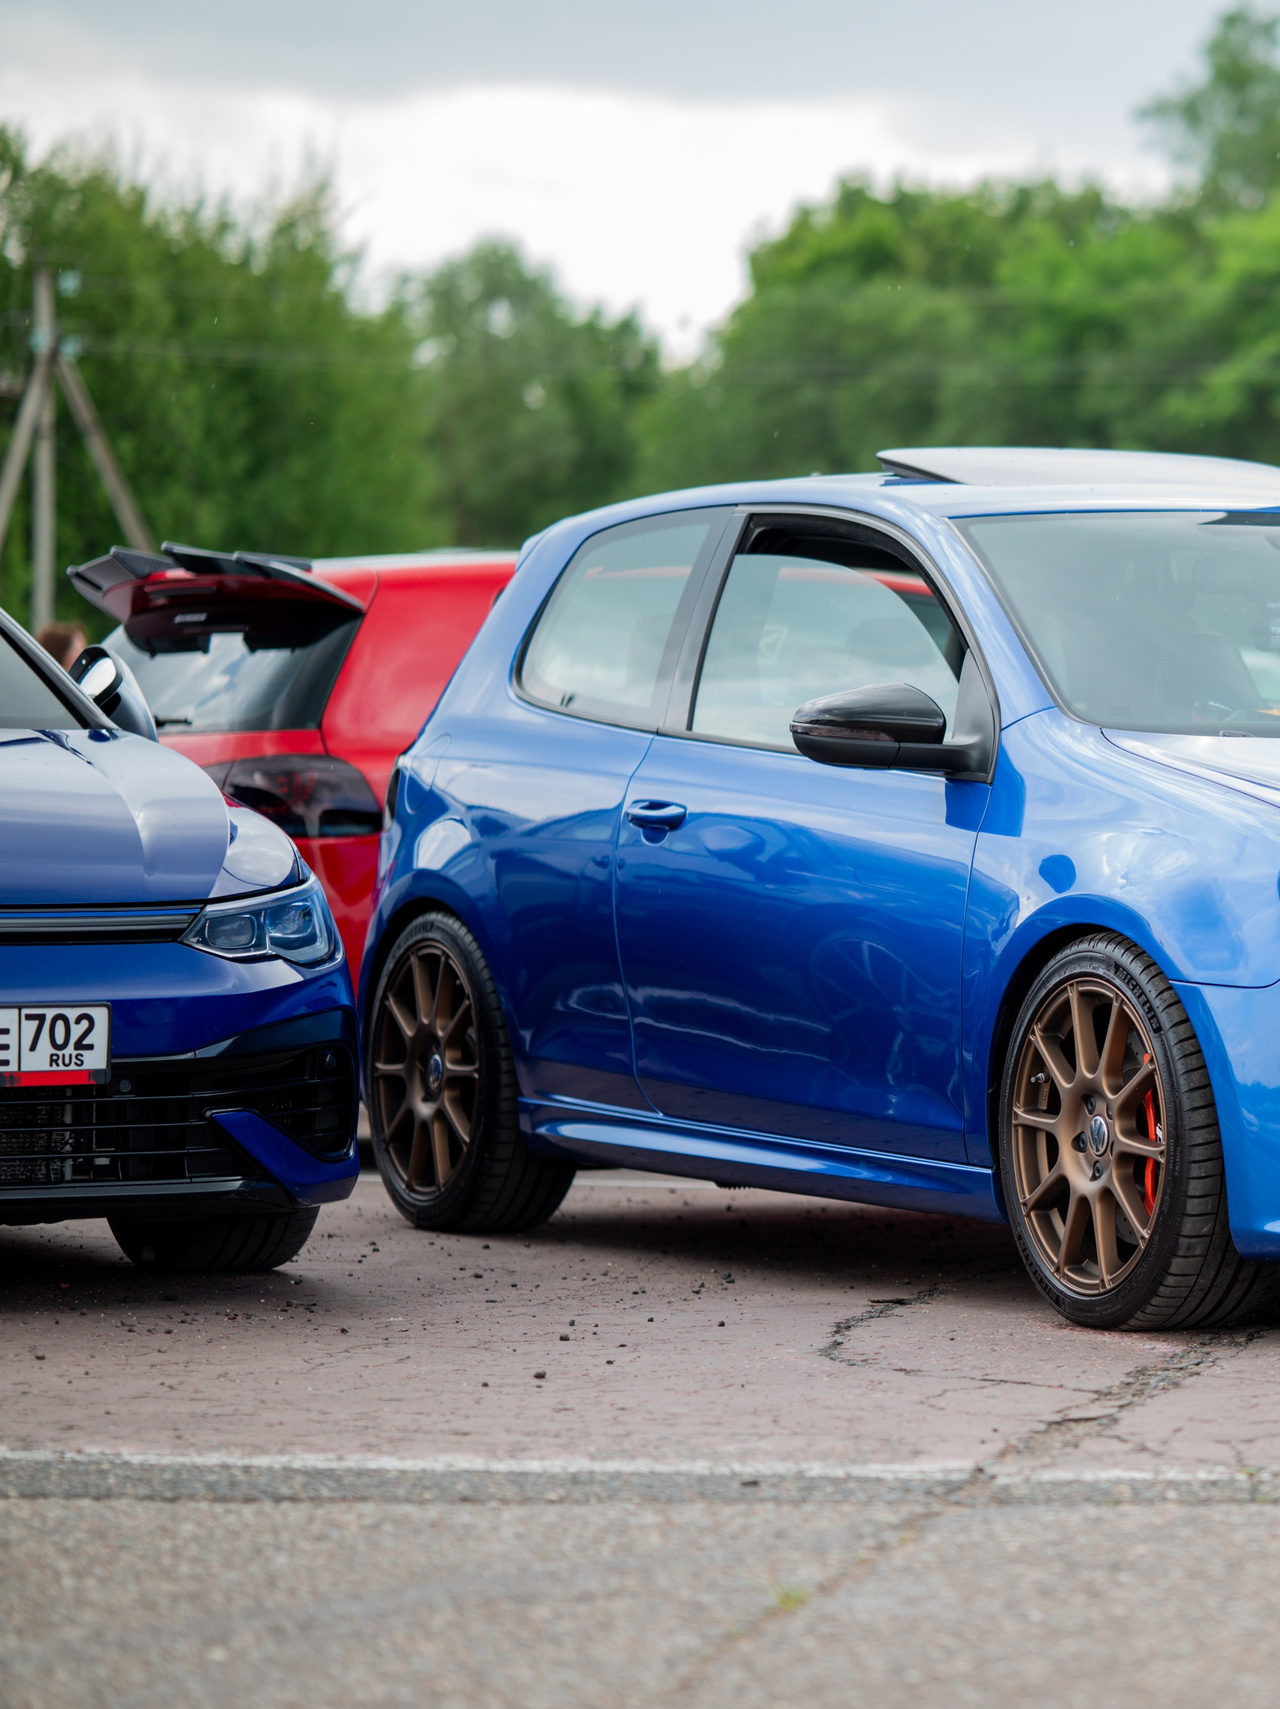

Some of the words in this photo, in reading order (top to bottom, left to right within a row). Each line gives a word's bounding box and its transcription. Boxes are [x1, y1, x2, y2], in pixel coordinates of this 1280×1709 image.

[1115, 966, 1161, 1031] MICHELIN
[24, 1012, 96, 1052] 702
[49, 1053, 84, 1068] RUS
